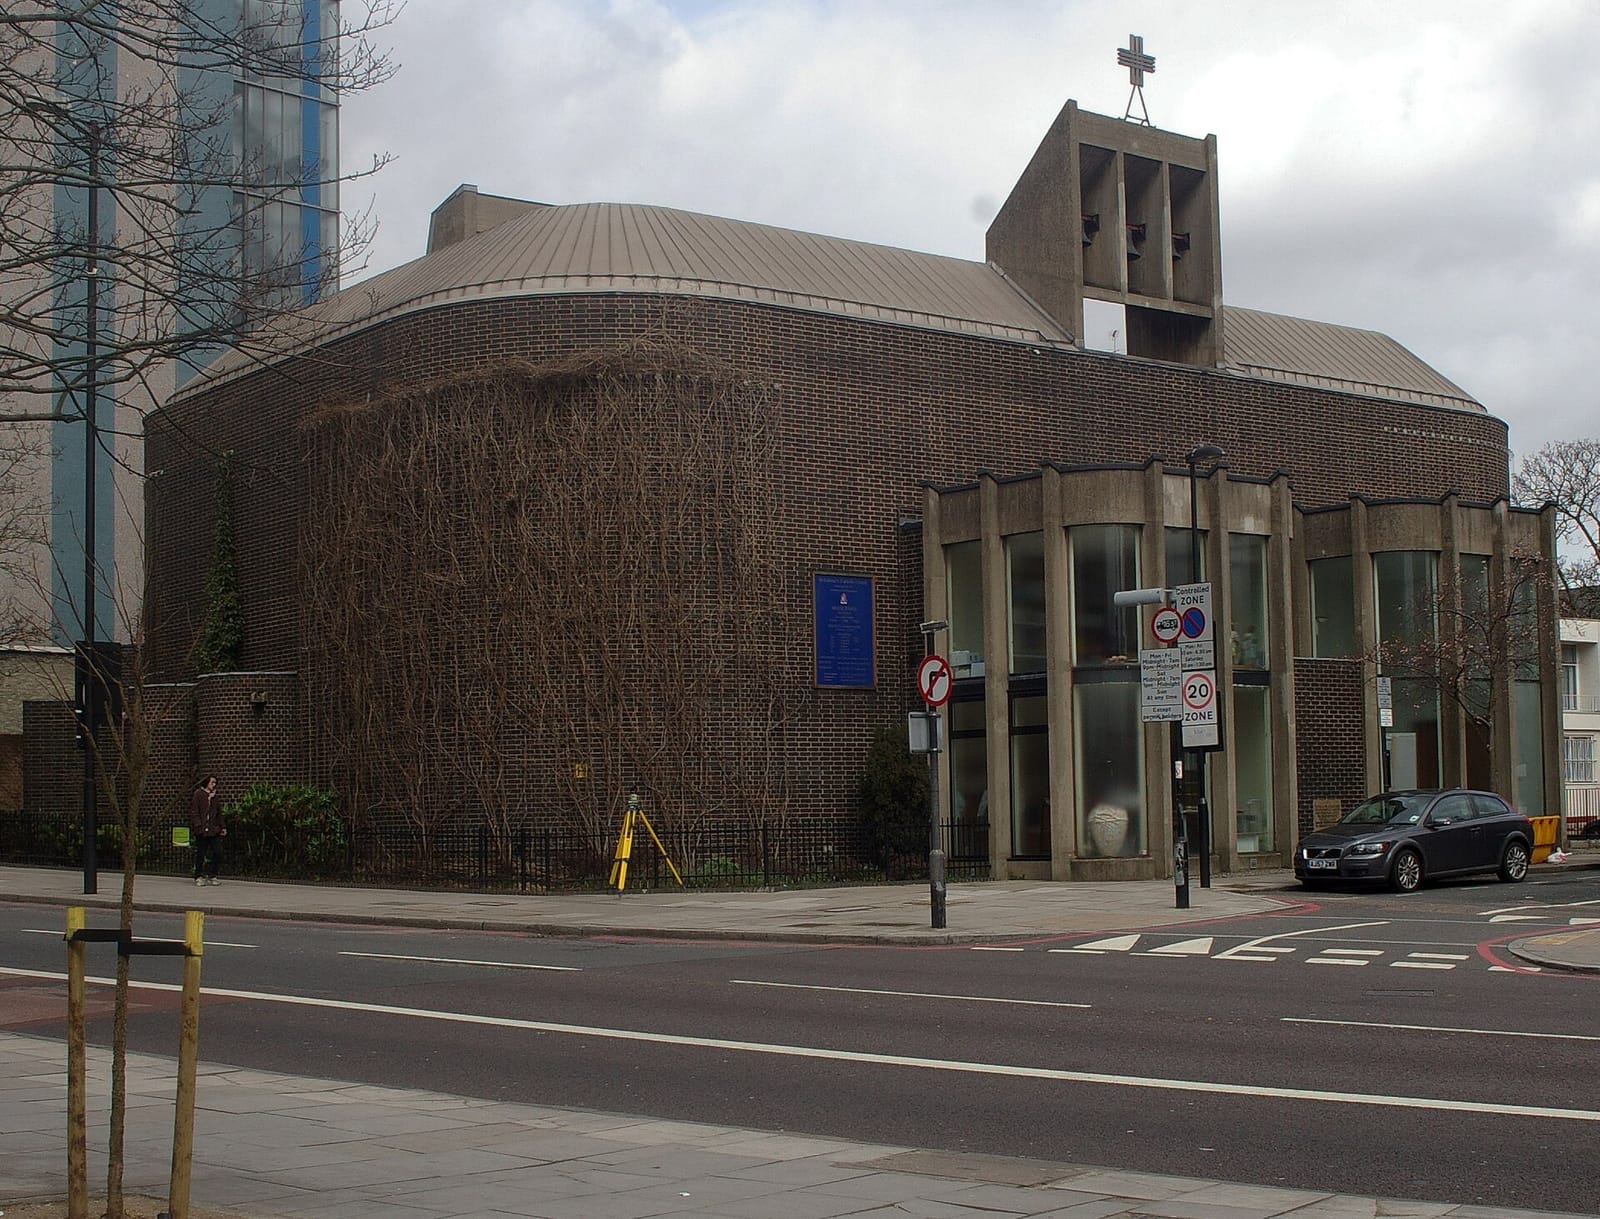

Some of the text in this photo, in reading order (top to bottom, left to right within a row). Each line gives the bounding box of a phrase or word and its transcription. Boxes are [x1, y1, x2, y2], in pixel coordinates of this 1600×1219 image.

[1175, 586, 1209, 595] Controlled
[1180, 595, 1205, 605] ZONE
[1188, 683, 1209, 698] 20
[1185, 711, 1213, 721] ZONE
